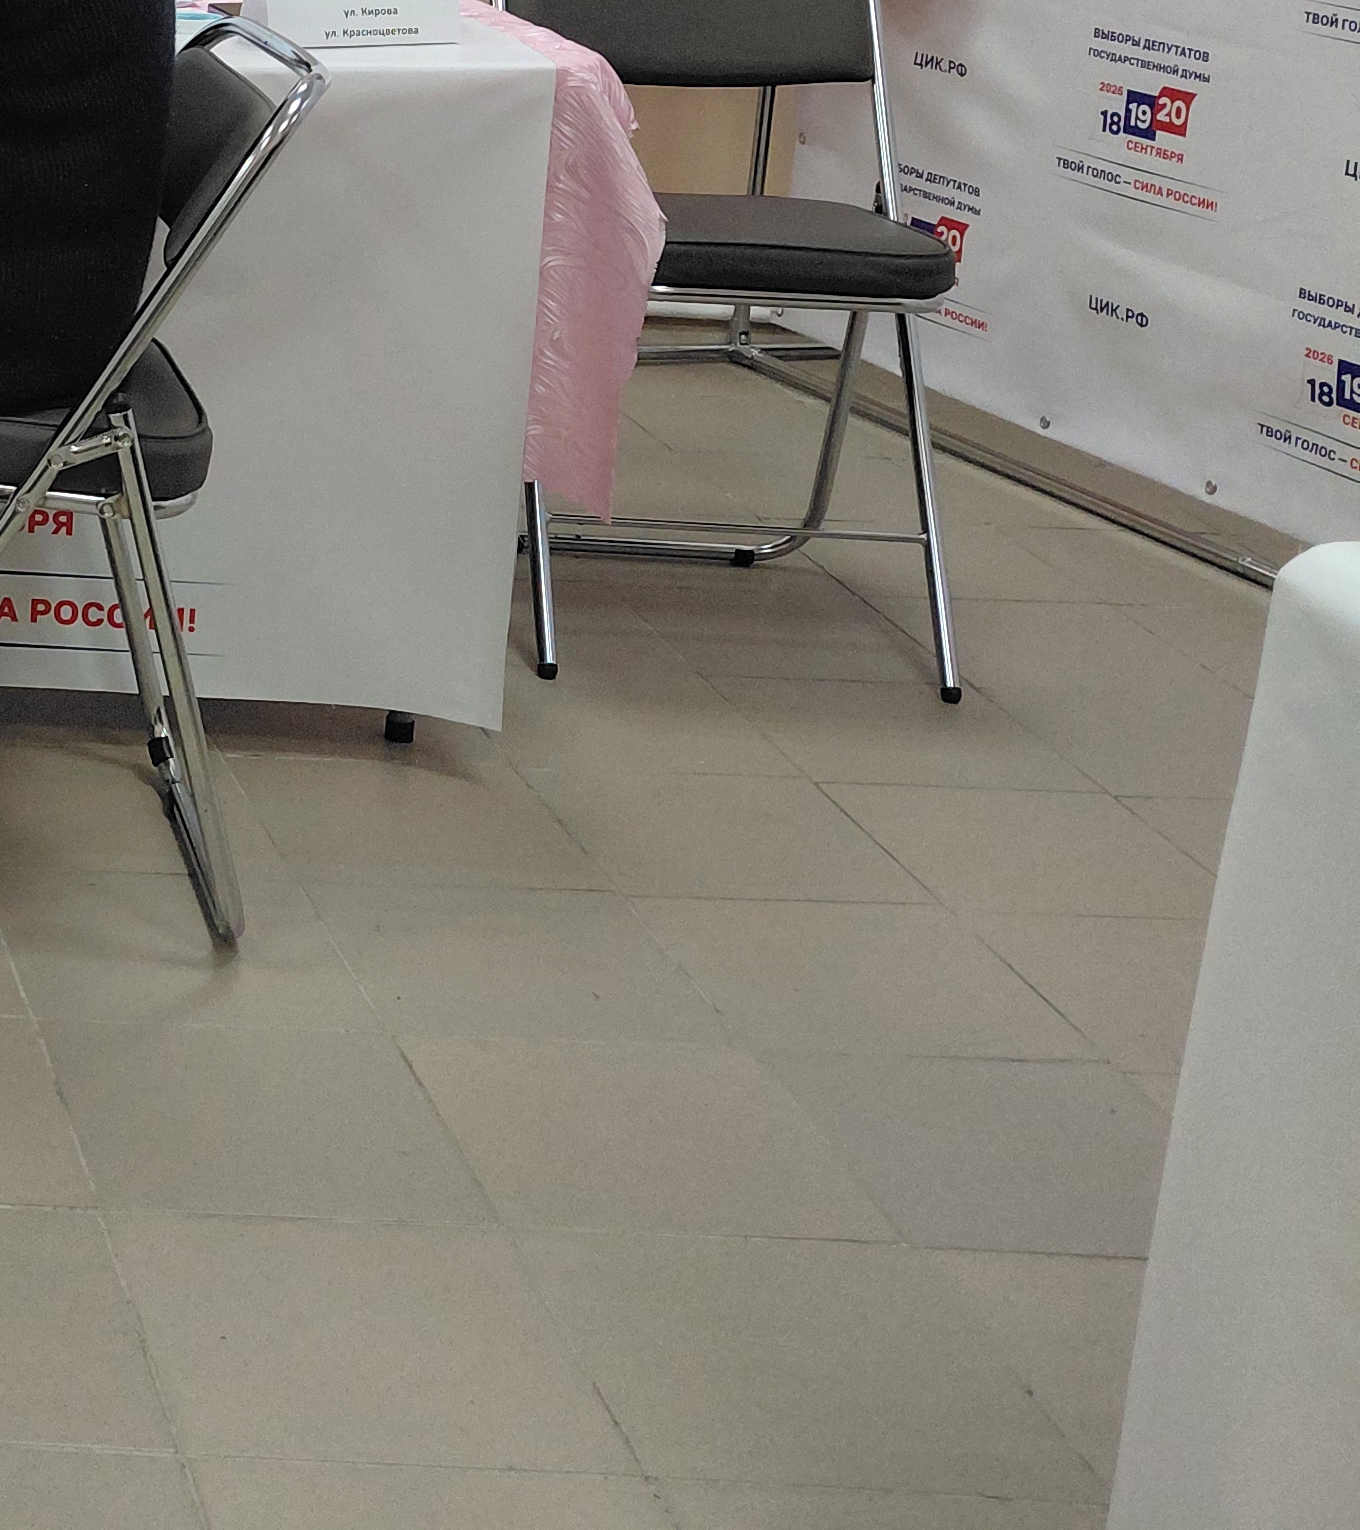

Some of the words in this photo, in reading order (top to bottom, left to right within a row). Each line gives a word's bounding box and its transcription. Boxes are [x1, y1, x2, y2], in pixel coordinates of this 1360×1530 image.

[344, 8, 358, 18] ул.
[361, 7, 398, 18] Кирова
[1304, 10, 1339, 30] ТВОЙ
[325, 30, 339, 40] ул.
[343, 27, 419, 39] Красноцветова
[1093, 28, 1141, 49] ВЫБОРЫ
[1143, 37, 1210, 63] ДЕПУТАТОВ
[913, 52, 968, 77] ЦИК.РФ
[1088, 47, 1178, 77] ГОСУДАРСТВЕННОЙ
[1180, 68, 1211, 84] ДУМЫ
[1099, 82, 1123, 96] 2026
[1100, 109, 1121, 136] 18
[1128, 102, 1152, 129] 19
[1156, 96, 1187, 126] 20
[1126, 140, 1184, 165] СЕНТЯБРЯ
[898, 163, 924, 180] БОРЫ
[925, 171, 980, 197] ДЕПУТАТОВ
[1056, 157, 1086, 178] ТВОЙ
[1086, 163, 1121, 186] ГОЛОС
[1133, 178, 1164, 199] СИЛА
[1166, 186, 1218, 213] РОССИИ!
[956, 200, 981, 216] ДУМЫ
[1087, 295, 1150, 328] ЦИК.РФ
[1299, 287, 1355, 315] ВЫБОРЫ
[944, 307, 987, 332] РОССИИ!
[1304, 347, 1333, 365] 2026
[1307, 378, 1334, 407] 18
[1257, 422, 1291, 445] ТВОЙ
[1295, 436, 1336, 462] ГОЛОС
